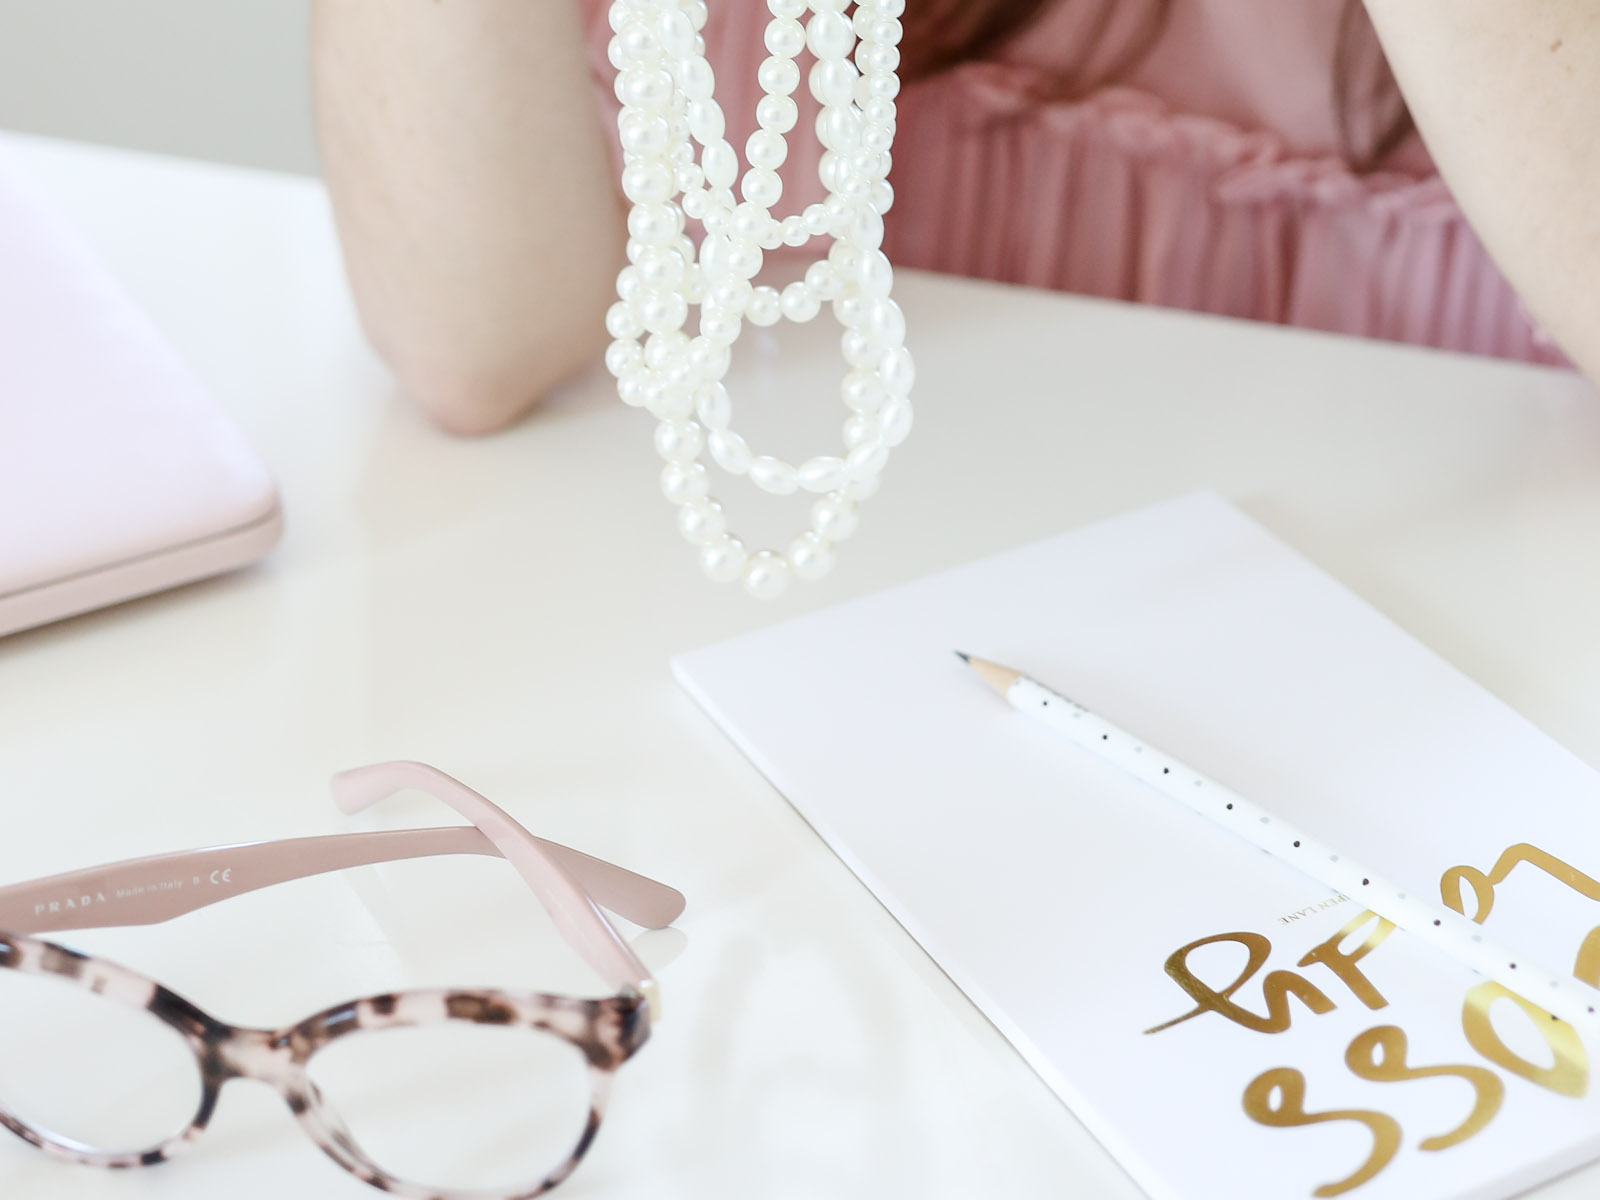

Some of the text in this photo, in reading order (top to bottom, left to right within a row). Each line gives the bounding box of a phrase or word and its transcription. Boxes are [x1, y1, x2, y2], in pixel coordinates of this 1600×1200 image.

[33, 892, 106, 917] PRADA
[115, 887, 145, 899] Made
[147, 883, 158, 893] in
[160, 879, 184, 891] Italy
[209, 867, 232, 885] CE
[1277, 906, 1317, 925] LANE
